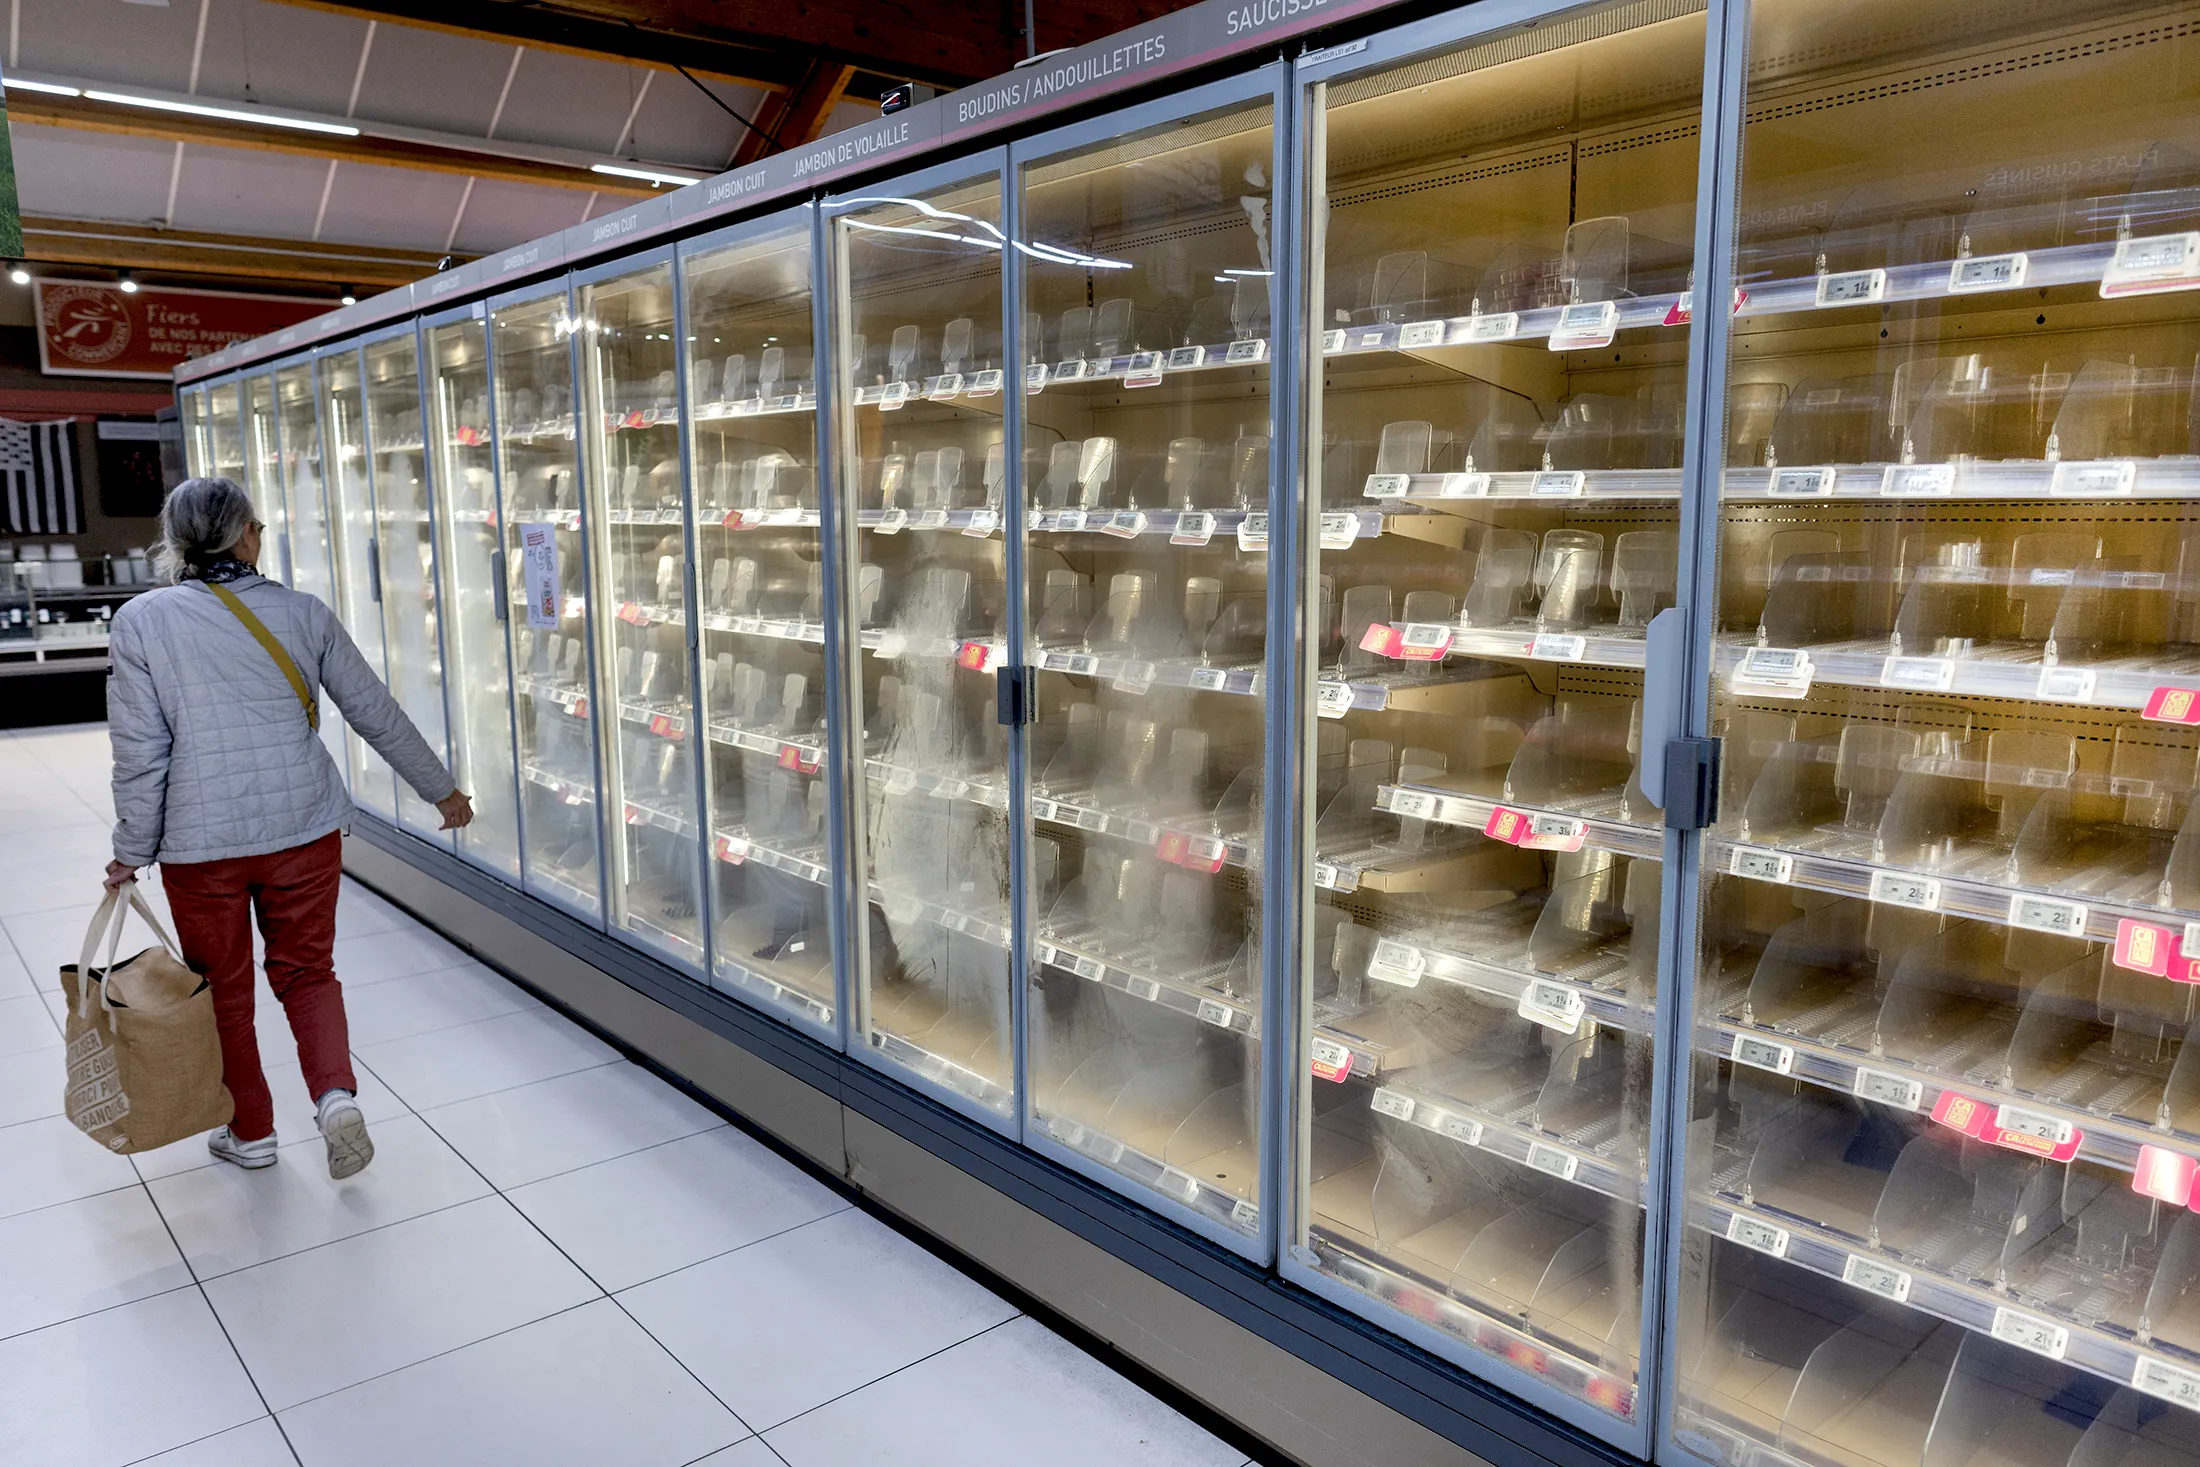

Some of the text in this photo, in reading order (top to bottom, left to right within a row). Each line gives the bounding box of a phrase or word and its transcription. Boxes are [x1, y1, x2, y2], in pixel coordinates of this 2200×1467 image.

[1227, 0, 1330, 35] SAUCIS
[959, 85, 1020, 123] BOUDINS
[1033, 35, 1166, 98] ANDOUILLETTES
[793, 122, 909, 178] JAMBON DE VOLAILLE
[708, 170, 766, 204] JAMBON CUIT
[592, 215, 637, 242] JAMBON CUIT
[146, 304, 200, 325] Fiers
